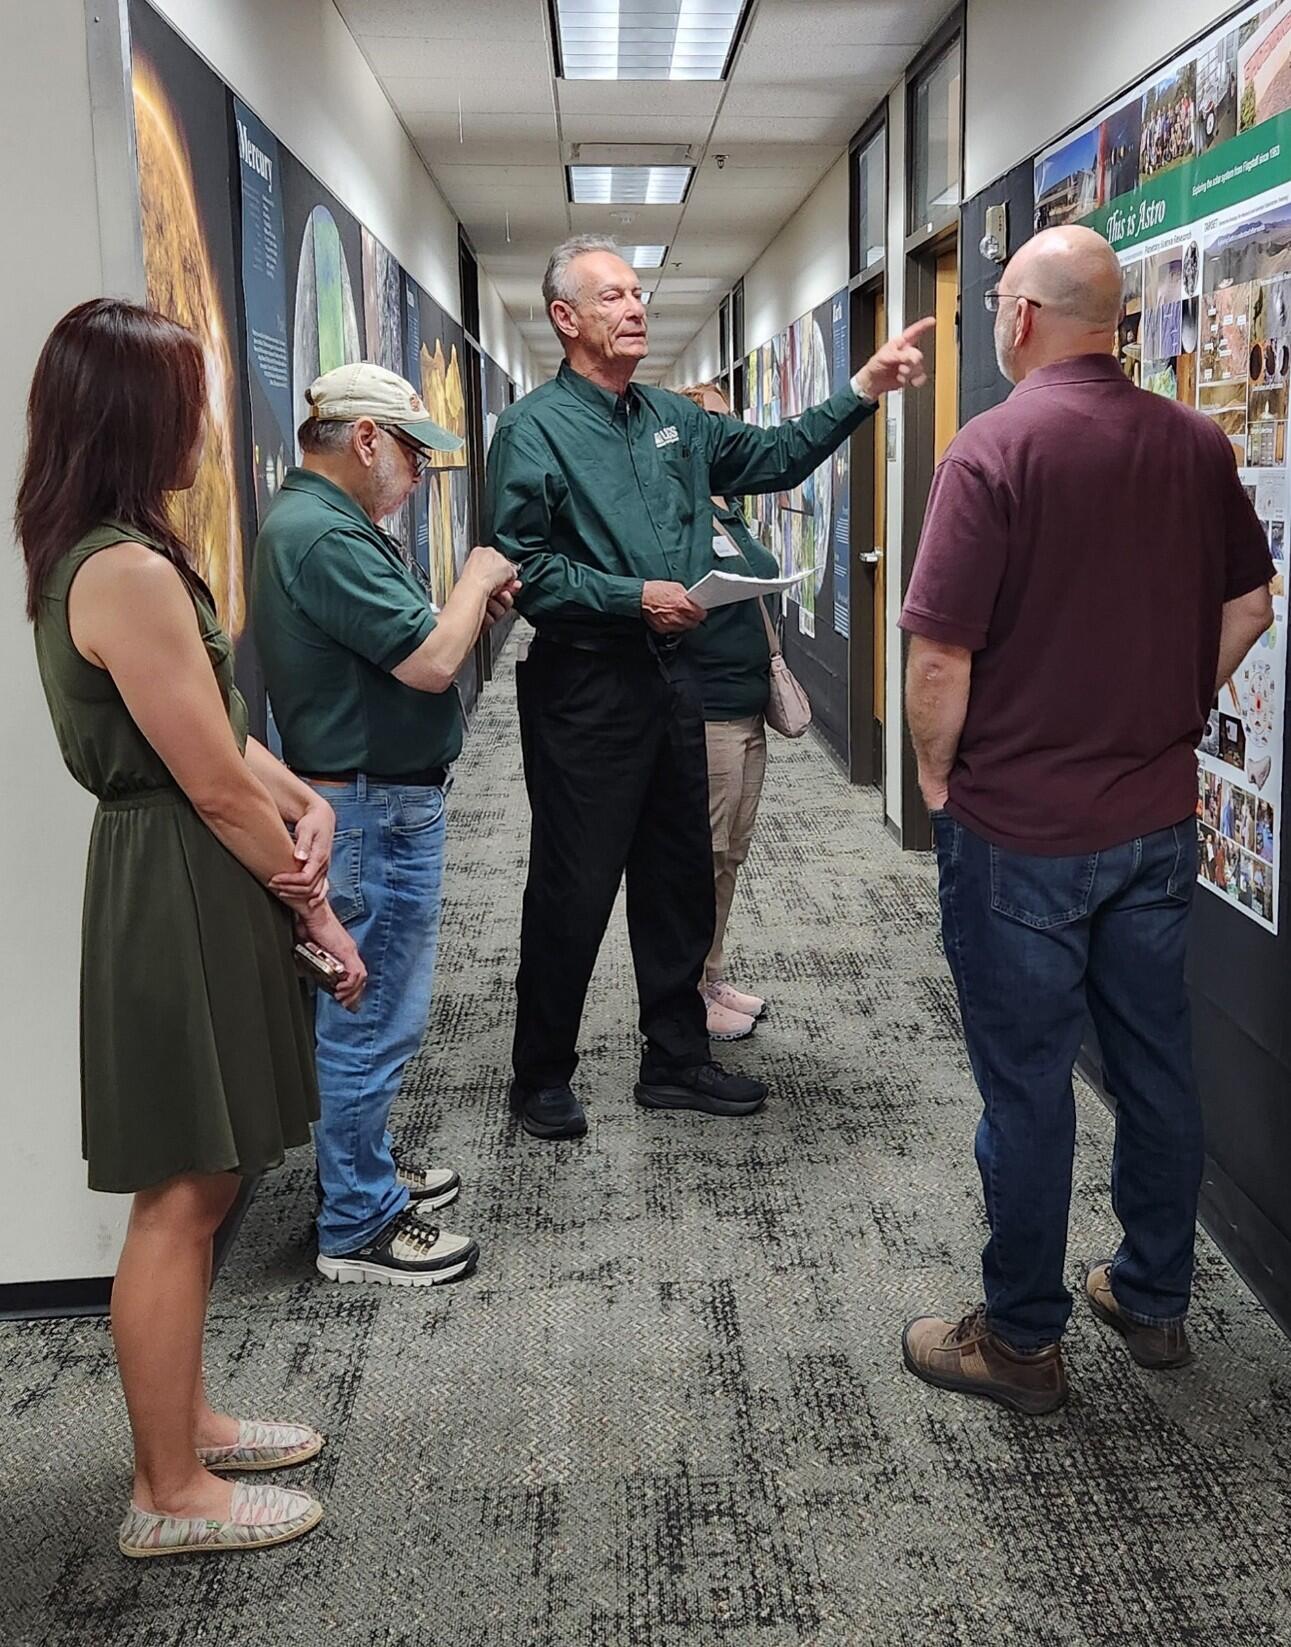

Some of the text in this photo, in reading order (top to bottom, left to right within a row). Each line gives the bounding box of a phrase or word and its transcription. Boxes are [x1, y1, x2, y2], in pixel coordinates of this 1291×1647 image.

[236, 119, 272, 193] Mercury
[1106, 199, 1166, 245] This is Astro
